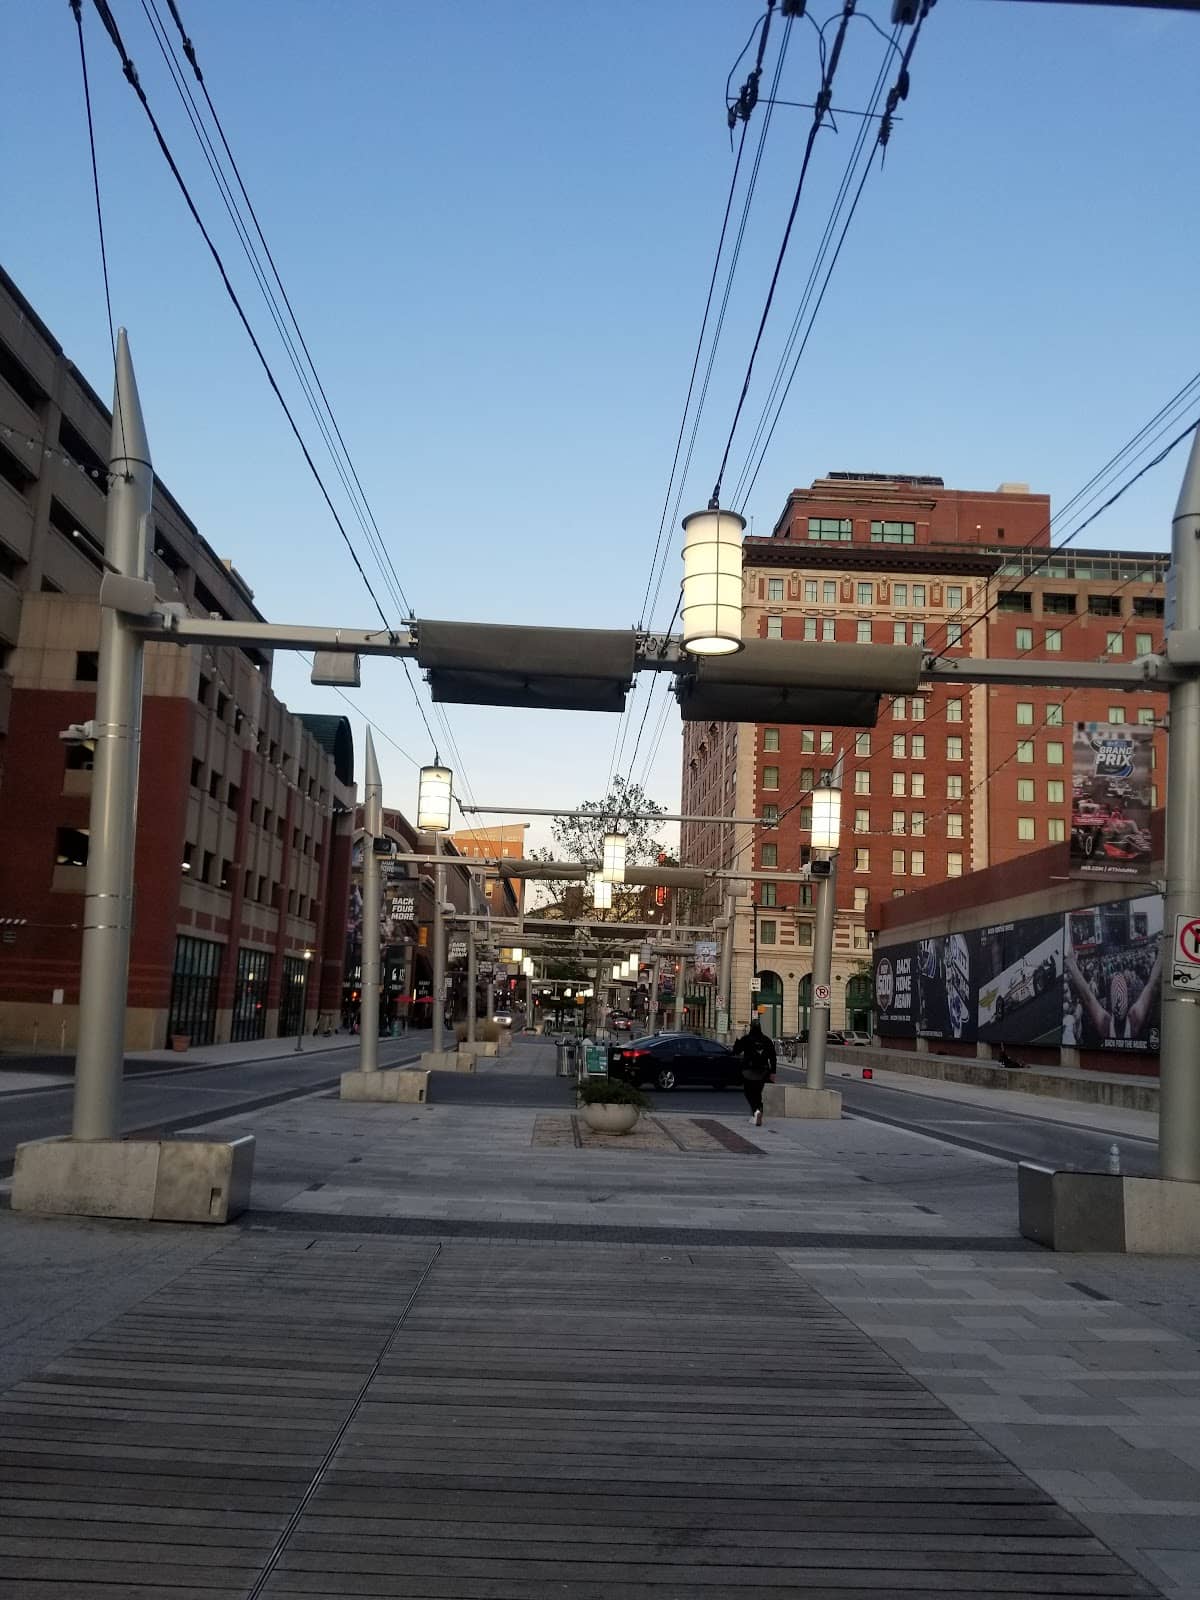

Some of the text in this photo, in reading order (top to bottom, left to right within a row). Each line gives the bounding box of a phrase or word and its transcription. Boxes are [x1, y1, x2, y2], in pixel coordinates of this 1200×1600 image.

[1099, 746, 1132, 755] GRAND
[1095, 754, 1133, 767] PRIX
[392, 897, 415, 905] BACK
[392, 905, 414, 913] FOUR
[391, 913, 415, 921] MORE
[896, 958, 912, 974] BACK
[878, 974, 891, 995] 500
[895, 975, 912, 992] HOME
[894, 993, 911, 1009] AGAIN
[1125, 1039, 1133, 1049] THE
